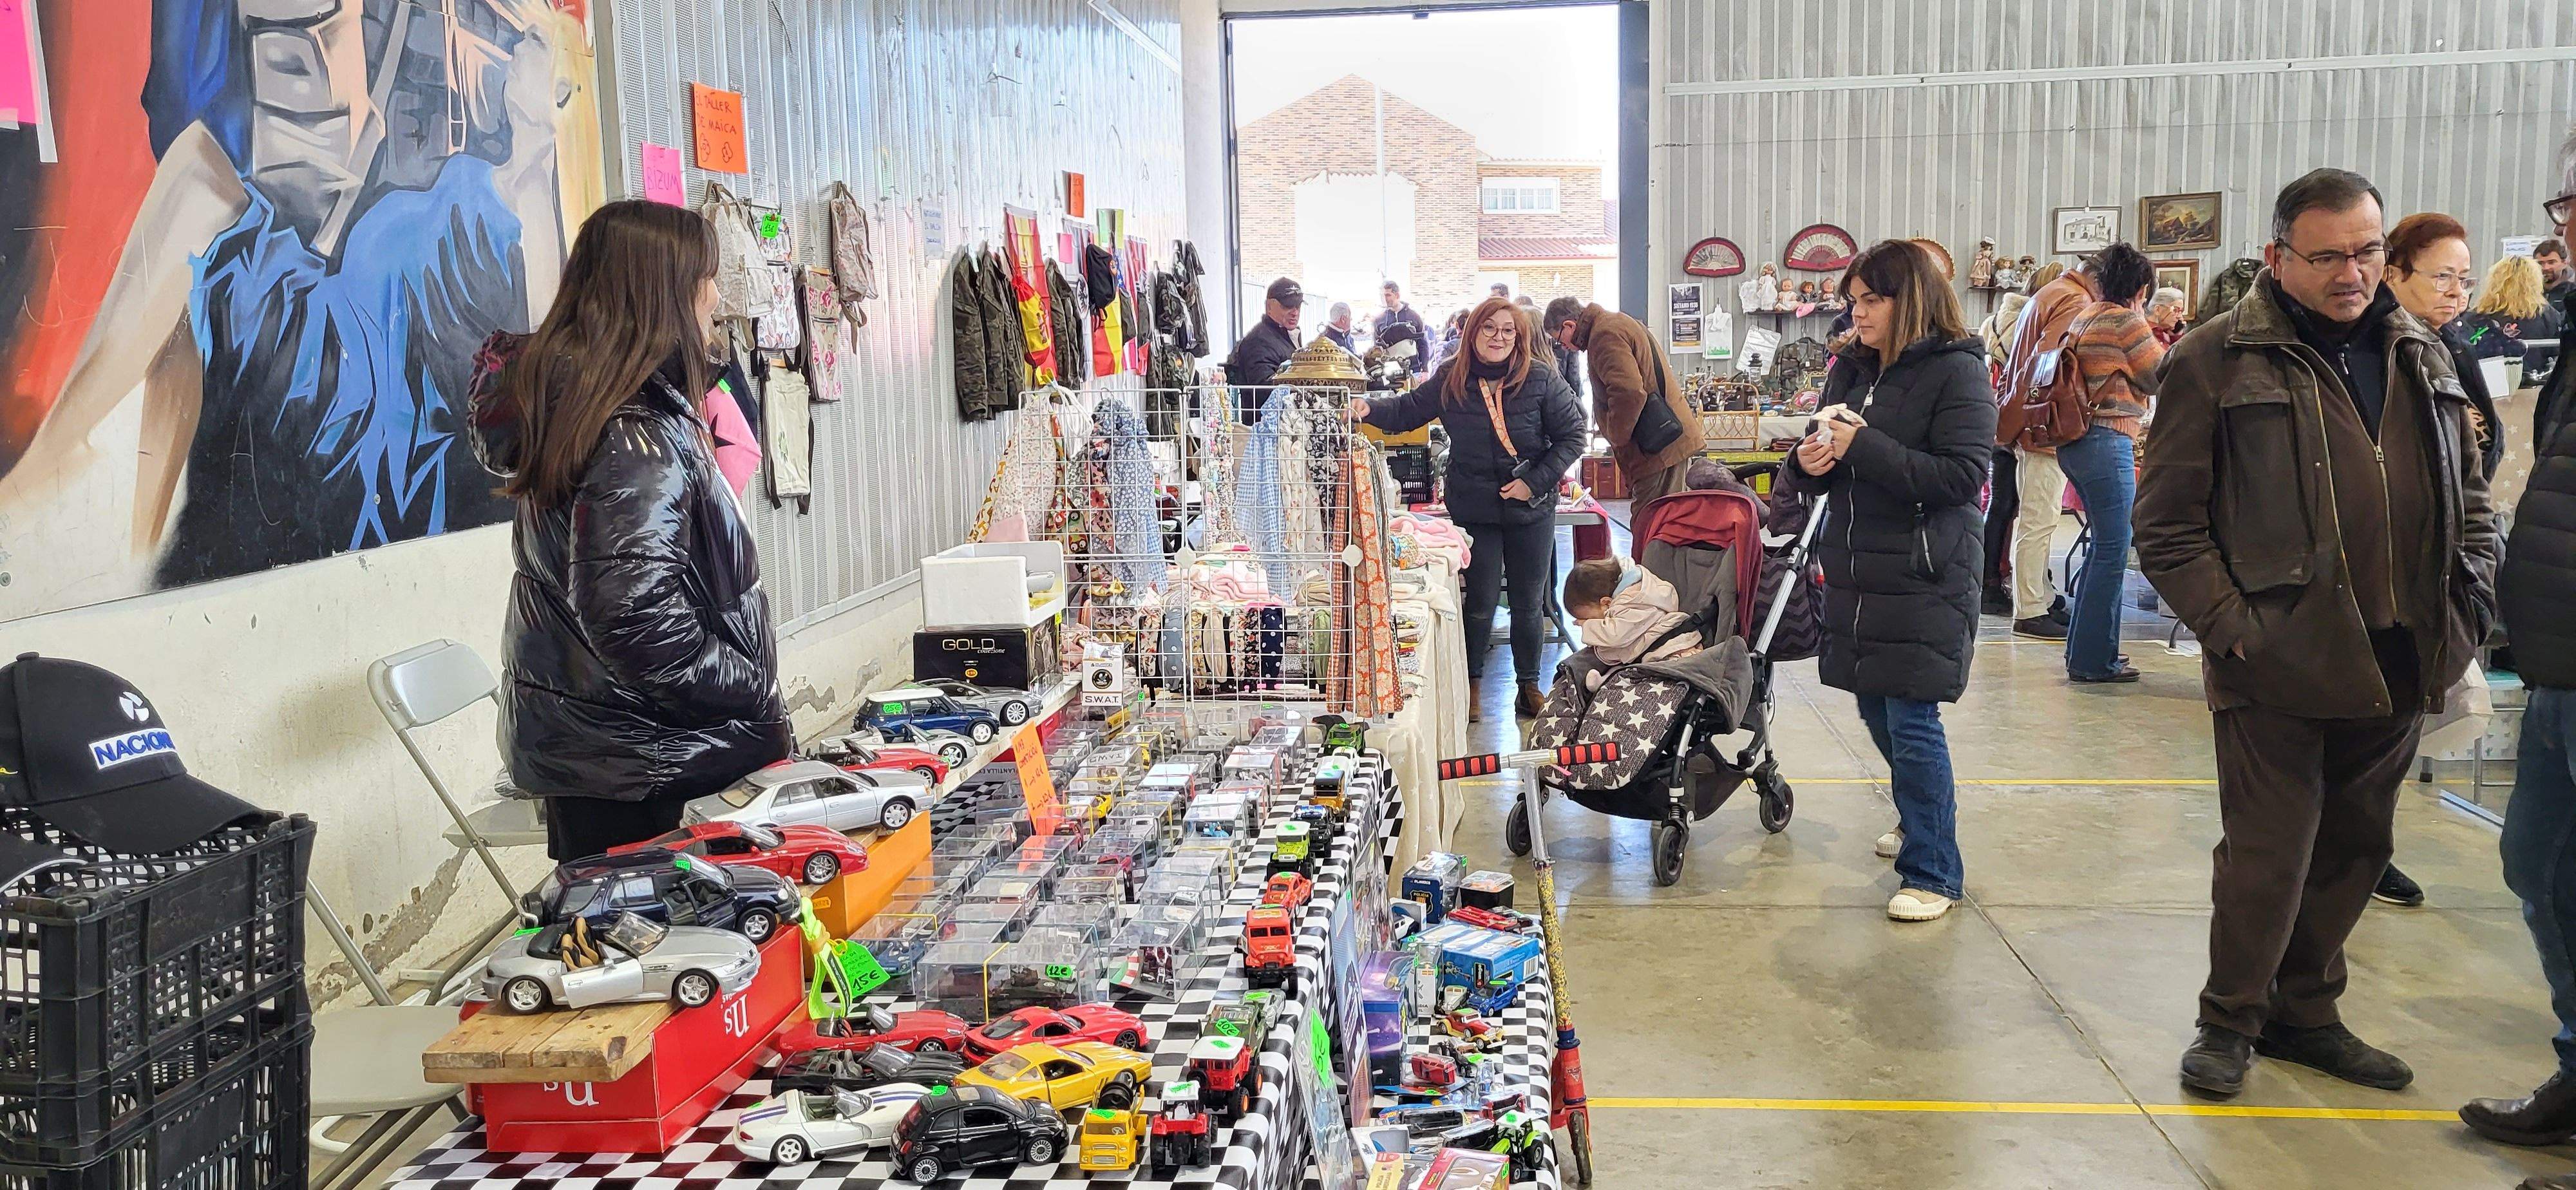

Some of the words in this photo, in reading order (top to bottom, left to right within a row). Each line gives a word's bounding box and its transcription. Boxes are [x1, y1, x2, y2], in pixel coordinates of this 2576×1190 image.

[704, 95, 732, 114] TALLER
[942, 638, 995, 650] GOLD
[1049, 965, 1068, 976] 12€
[852, 969, 880, 992] 15€
[1217, 1020, 1237, 1035] 10€
